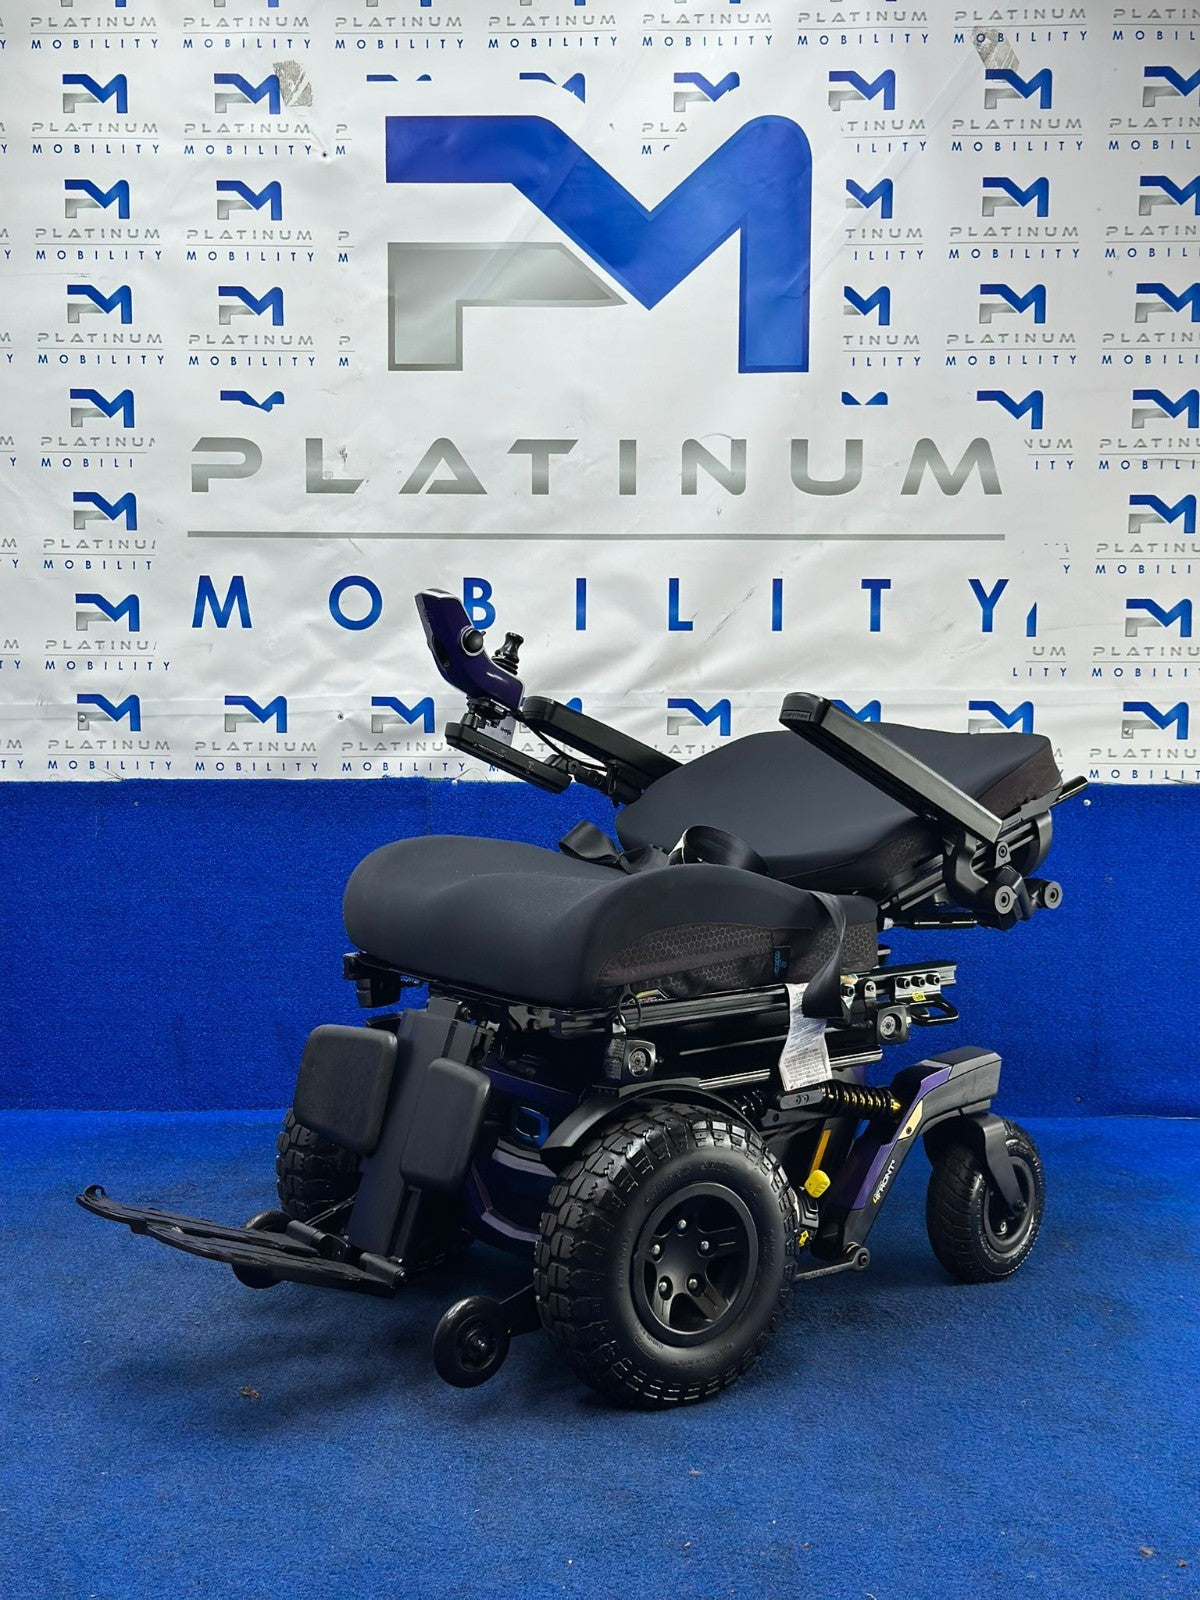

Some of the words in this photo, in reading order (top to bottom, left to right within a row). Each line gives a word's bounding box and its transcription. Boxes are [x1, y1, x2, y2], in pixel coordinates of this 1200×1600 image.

[643, 13, 771, 24] PLATINUM
[798, 11, 927, 22] PLATINUM
[955, 8, 1086, 21] PLATINUM
[30, 17, 157, 27] PLATINUM
[184, 17, 309, 27] PLATINUM
[336, 17, 462, 27] PLATINUM
[489, 15, 615, 26] PLATINUM
[797, 32, 928, 45] MOBILITY
[952, 31, 1088, 43] MOBILITY
[1113, 30, 1195, 40] MOBIL
[31, 39, 158, 49] MOBILITY
[183, 38, 310, 49] MOBILITY
[335, 39, 463, 49] MOBILITY
[488, 36, 617, 48] MOBILITY
[642, 35, 772, 46] MOBILITY
[32, 123, 158, 133] PLATINUM
[184, 123, 310, 133] PLATINUM
[840, 118, 926, 132] TINUM
[952, 119, 1081, 129] PLATINUM
[32, 144, 159, 154] MOBILITY
[184, 145, 311, 155] MOBILITY
[952, 141, 1083, 152] MOBILITY
[1109, 140, 1191, 150] MOBIL
[36, 228, 160, 238] PLATINUM
[187, 230, 312, 240] PLATINUM
[950, 227, 1078, 237] PLATINUM
[1106, 226, 1196, 235] PLATIN
[385, 114, 813, 374] PM
[36, 250, 161, 260] MOBILITY
[187, 251, 314, 262] MOBILITY
[949, 249, 1079, 259] MOBILITY
[1105, 248, 1200, 258] MOBIL
[38, 333, 162, 343] PLATINUM
[189, 335, 313, 345] PLATINUM
[947, 333, 1075, 344] PLATINUM
[1101, 331, 1200, 345] PLATIN
[38, 354, 164, 365] MOBILITY
[189, 356, 315, 366] MOBILITY
[946, 355, 1076, 366] MOBILITY
[1102, 354, 1198, 364] MOBILI
[41, 458, 132, 468] MOBILI
[190, 437, 1003, 497] PLATINUM
[1098, 459, 1197, 471] MOBILI
[44, 539, 156, 549] PLATINU
[44, 560, 151, 570] MOBILIT
[1095, 565, 1191, 574] MOBILI
[190, 573, 1010, 634] MOBILITY
[45, 639, 158, 652] PLATINU
[45, 661, 170, 671] MOBILITY
[1091, 665, 1200, 678] MOBILI
[48, 740, 170, 750] PLATINUM
[195, 742, 316, 751] PLATINUM
[341, 742, 452, 752] PLATINU
[1090, 748, 1196, 758] PLATINU
[47, 759, 173, 771] MOBILITY
[195, 762, 318, 771] MOBILITY
[341, 763, 466, 773] MOBILITY
